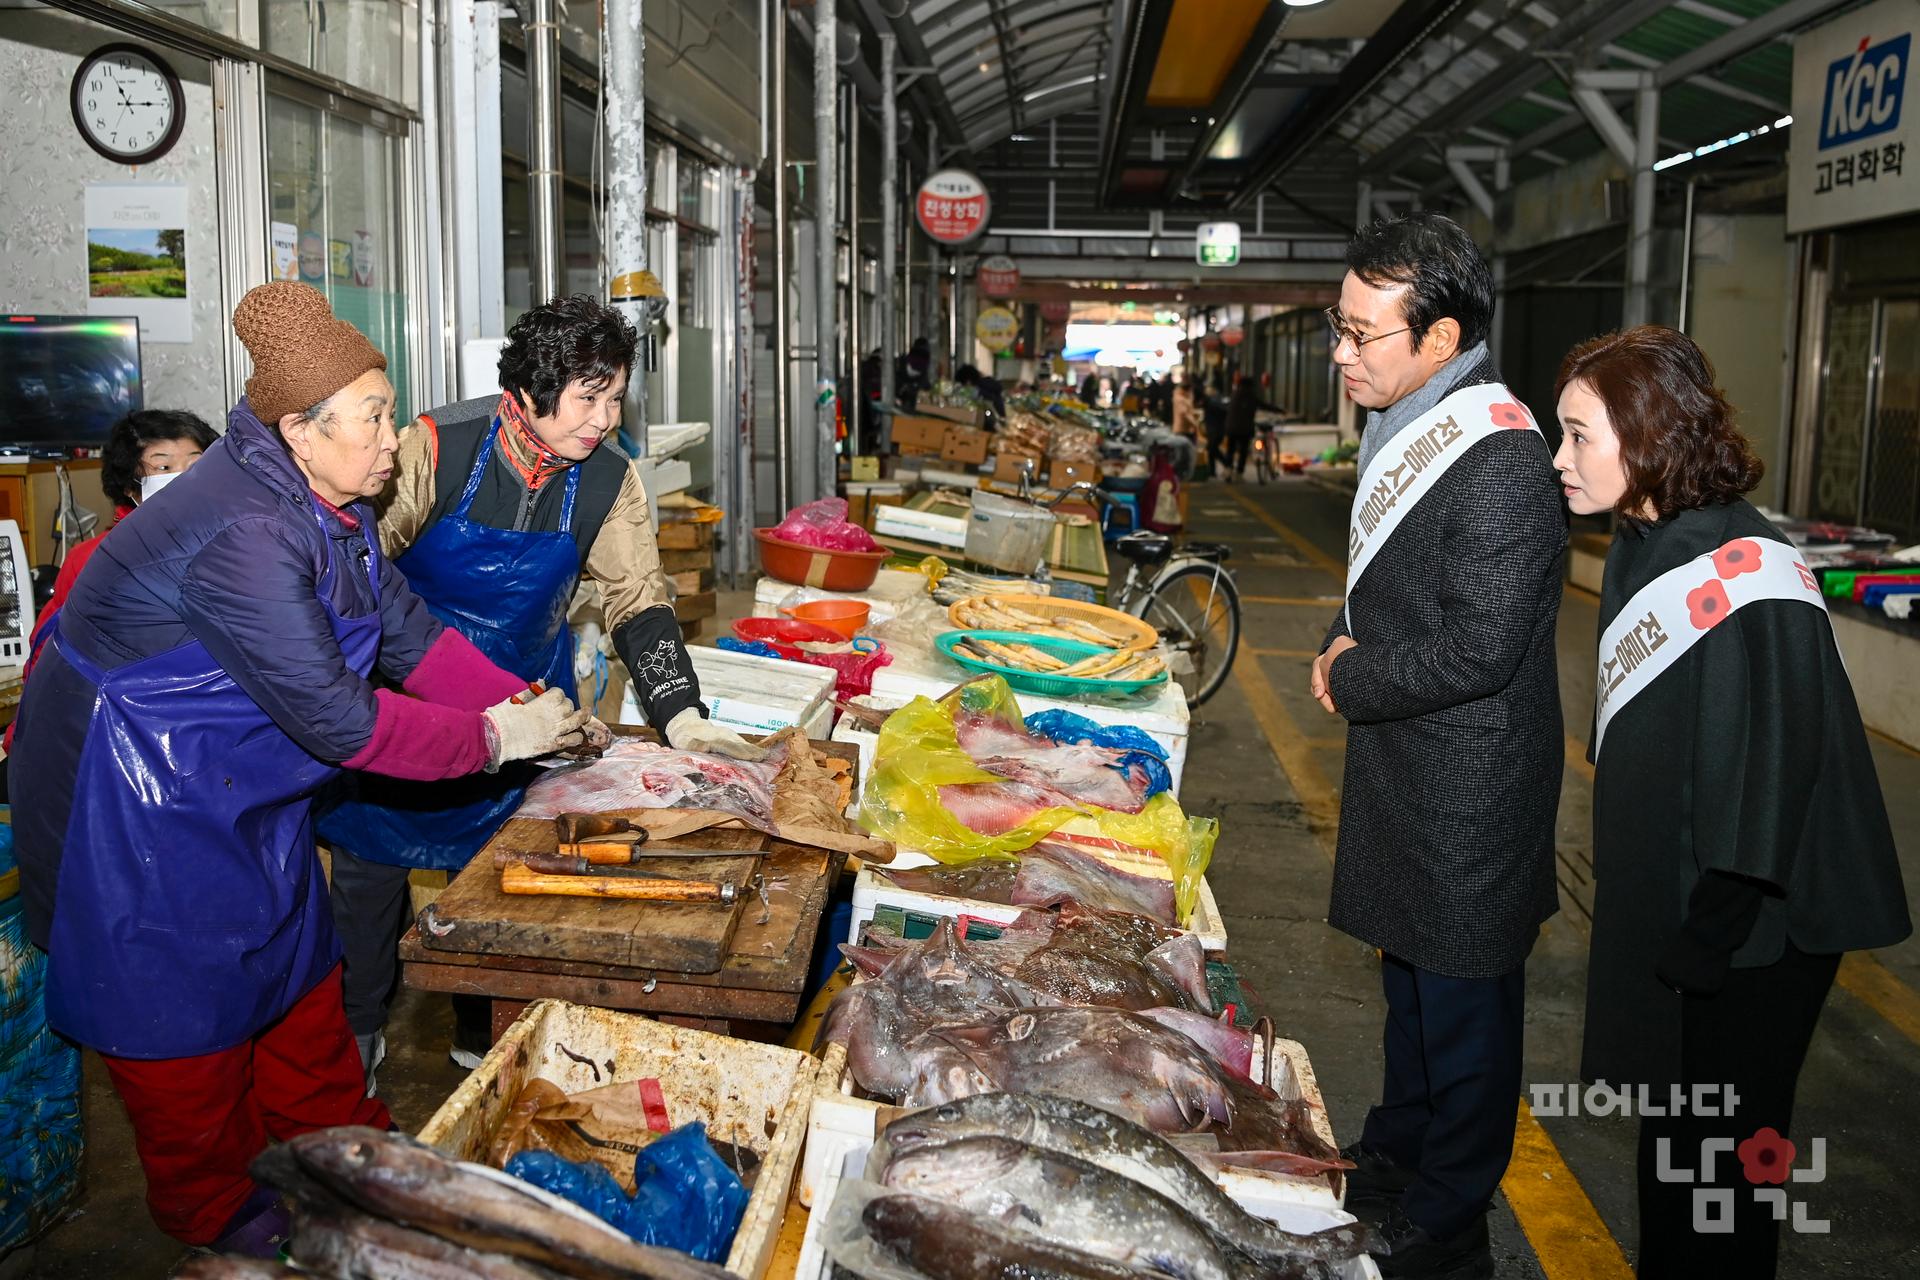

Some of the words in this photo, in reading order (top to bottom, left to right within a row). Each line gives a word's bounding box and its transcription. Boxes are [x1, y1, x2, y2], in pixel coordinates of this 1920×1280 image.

[120, 58, 131, 70] 12
[142, 64, 146, 76] 1
[103, 65, 112, 77] 11
[91, 80, 102, 92] 10
[154, 79, 163, 91] 2
[1827, 36, 1900, 139] KCC
[88, 99, 97, 111] 9
[96, 118, 106, 129] 8
[110, 131, 117, 144] 7
[129, 136, 137, 149] 6
[147, 131, 155, 142] 5
[1814, 141, 1905, 195] 고려화학
[1358, 415, 1464, 537] 전통시장을
[670, 676, 689, 686] TIRE
